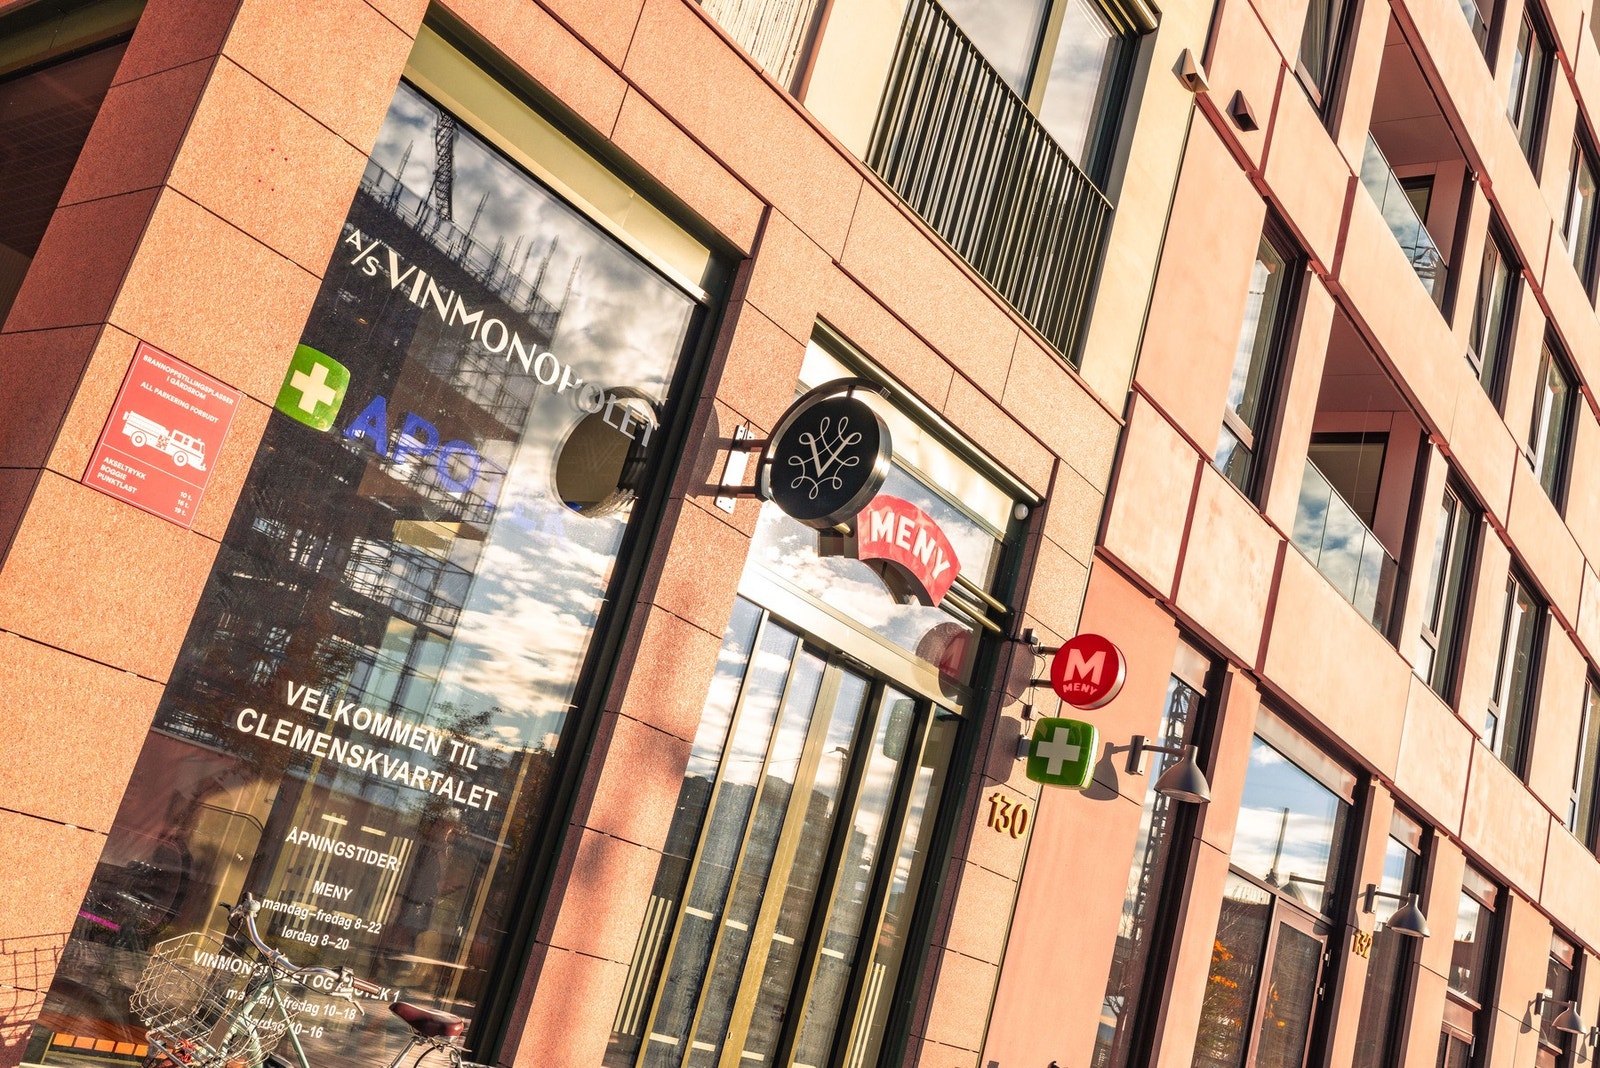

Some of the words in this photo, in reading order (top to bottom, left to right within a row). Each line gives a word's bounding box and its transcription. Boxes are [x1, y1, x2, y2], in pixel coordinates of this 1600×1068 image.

[345, 229, 380, 276] A/S
[143, 354, 234, 406] BRANNOPPSTILLINGSPLASSER
[170, 378, 207, 400] GÅRDSROM
[140, 381, 154, 392] ALL
[154, 387, 190, 410] PARKERING
[190, 405, 219, 424] FORBUDT
[97, 472, 138, 494] PUNKTLAST
[100, 464, 127, 481] BOGGIE
[103, 456, 147, 480] AKSELTRYKK
[870, 510, 950, 580] MENY
[1063, 648, 1107, 686] M
[1062, 682, 1098, 696] MENY
[286, 681, 443, 757] VELKOMMEN
[449, 739, 479, 771] TIL
[236, 708, 498, 811] CLEMENSKVARTALET
[987, 792, 1030, 840] 130
[285, 826, 402, 873] ÅPNINGSTIDER:
[312, 880, 354, 901] MENY
[261, 898, 352, 930] mandag–fredag
[354, 917, 383, 935] 8–22
[281, 925, 320, 947] lørdag
[320, 934, 350, 951] 8–20
[1352, 930, 1373, 959] 132
[313, 974, 335, 990] OG
[393, 990, 400, 1003] 1
[323, 1003, 357, 1020] 10–18
